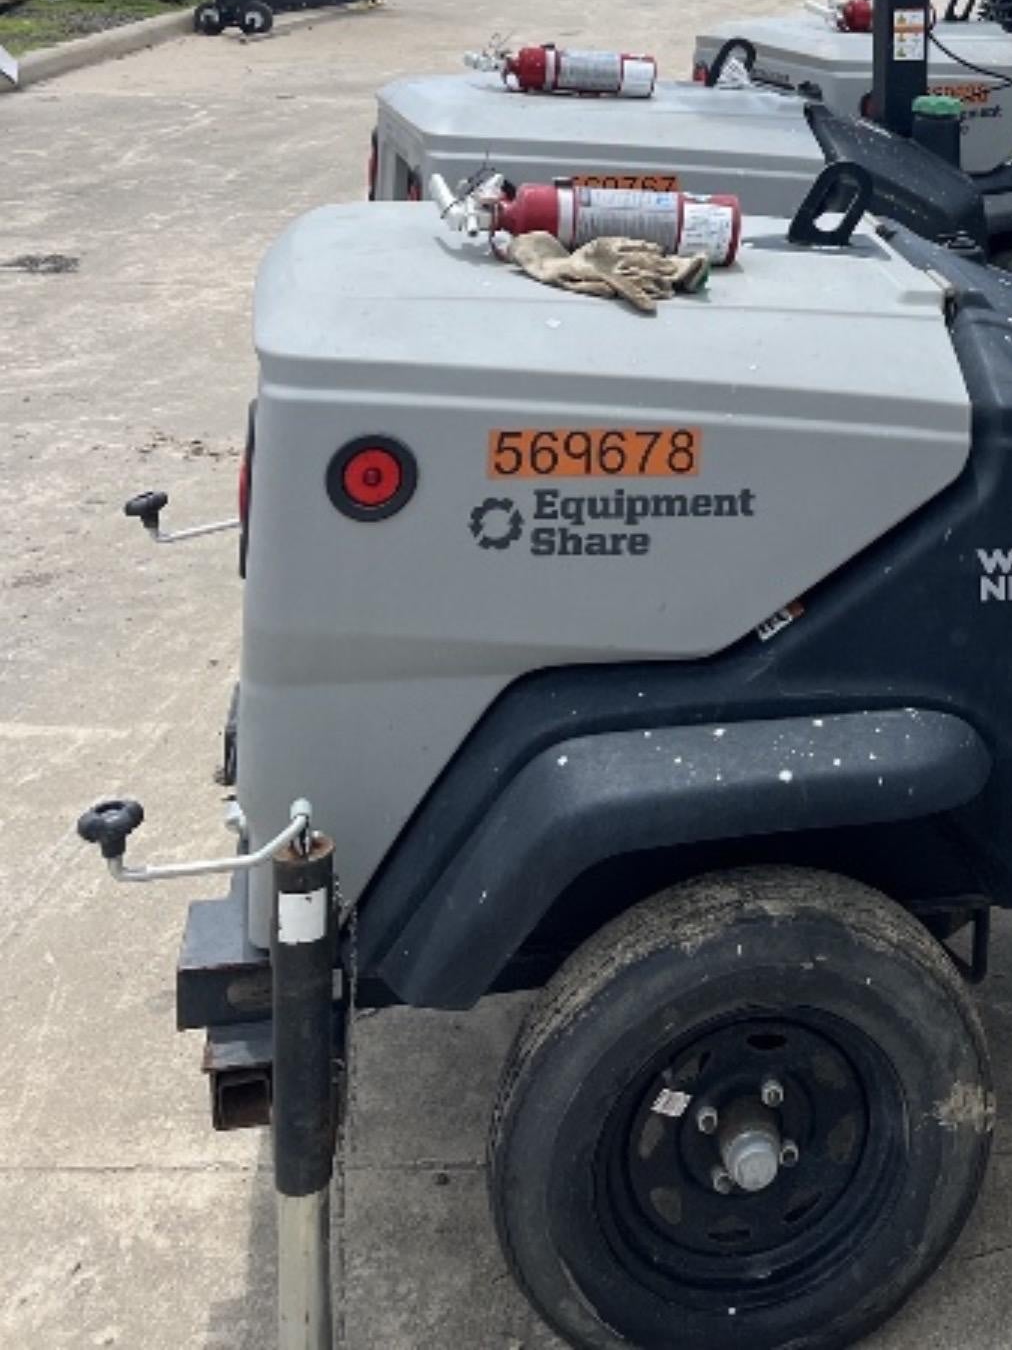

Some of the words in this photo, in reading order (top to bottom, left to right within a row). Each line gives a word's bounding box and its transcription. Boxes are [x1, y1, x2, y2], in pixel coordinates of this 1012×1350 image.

[493, 430, 695, 475] 569678
[532, 489, 756, 526] Equipment
[530, 527, 651, 556] Share
